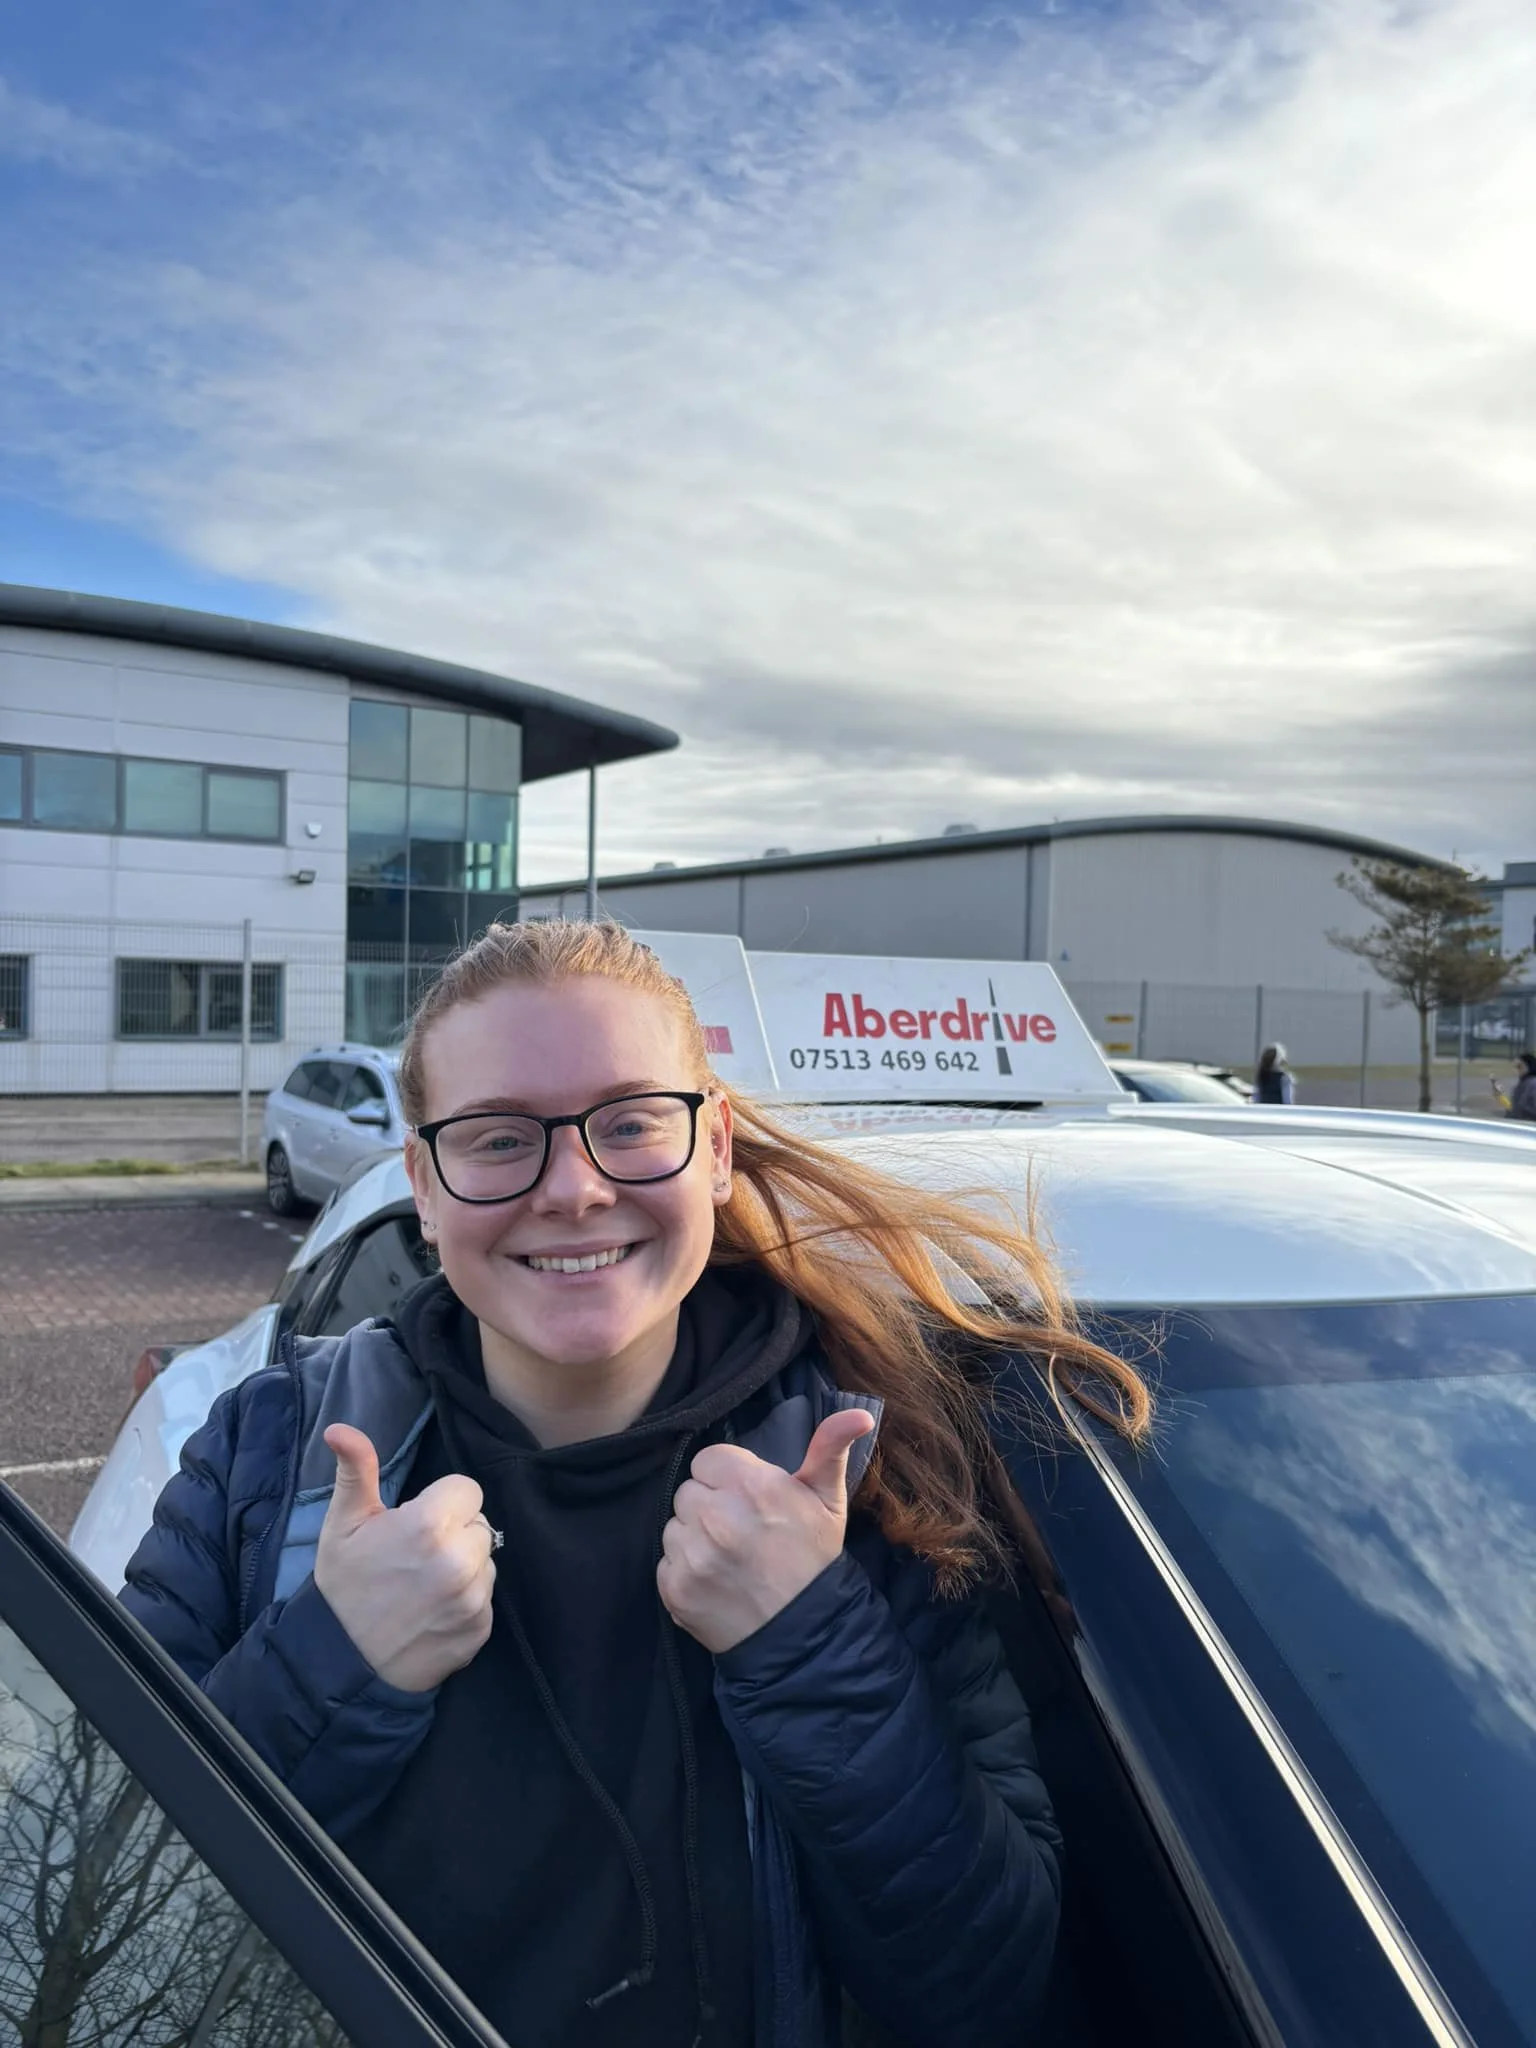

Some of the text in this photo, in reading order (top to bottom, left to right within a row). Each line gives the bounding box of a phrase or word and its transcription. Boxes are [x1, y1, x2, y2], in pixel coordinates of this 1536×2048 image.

[823, 980, 1057, 1043] Aberdrive
[789, 1048, 979, 1071] 07513 469 642
